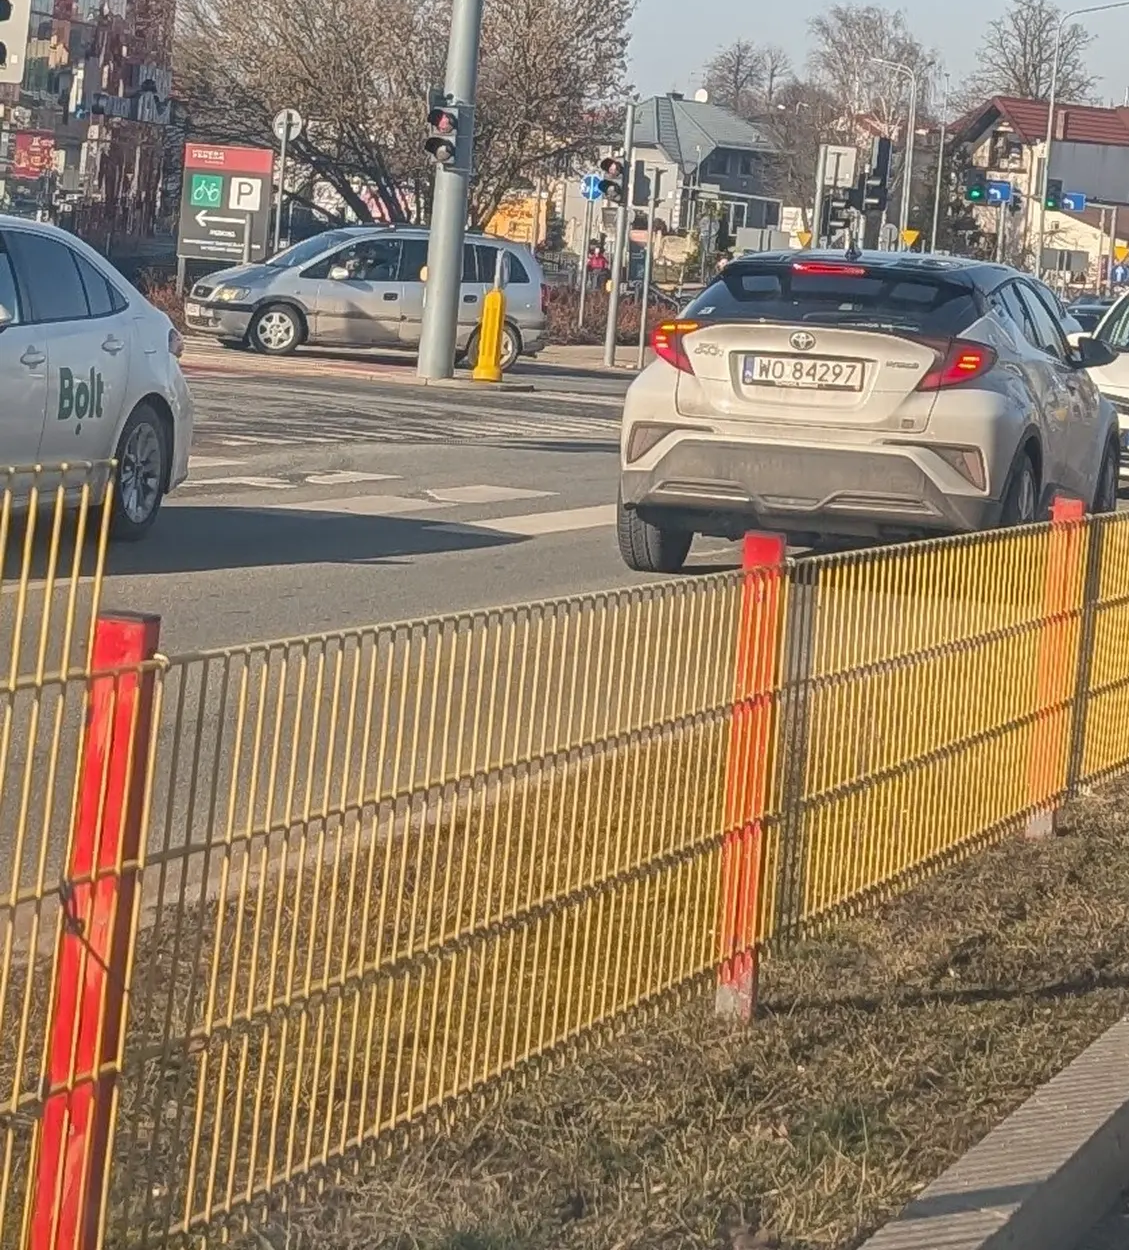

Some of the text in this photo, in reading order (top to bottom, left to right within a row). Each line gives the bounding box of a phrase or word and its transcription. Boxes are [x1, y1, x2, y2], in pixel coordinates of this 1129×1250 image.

[236, 181, 254, 206] P
[759, 358, 858, 384] WO 84297
[57, 365, 104, 436] Bolt
